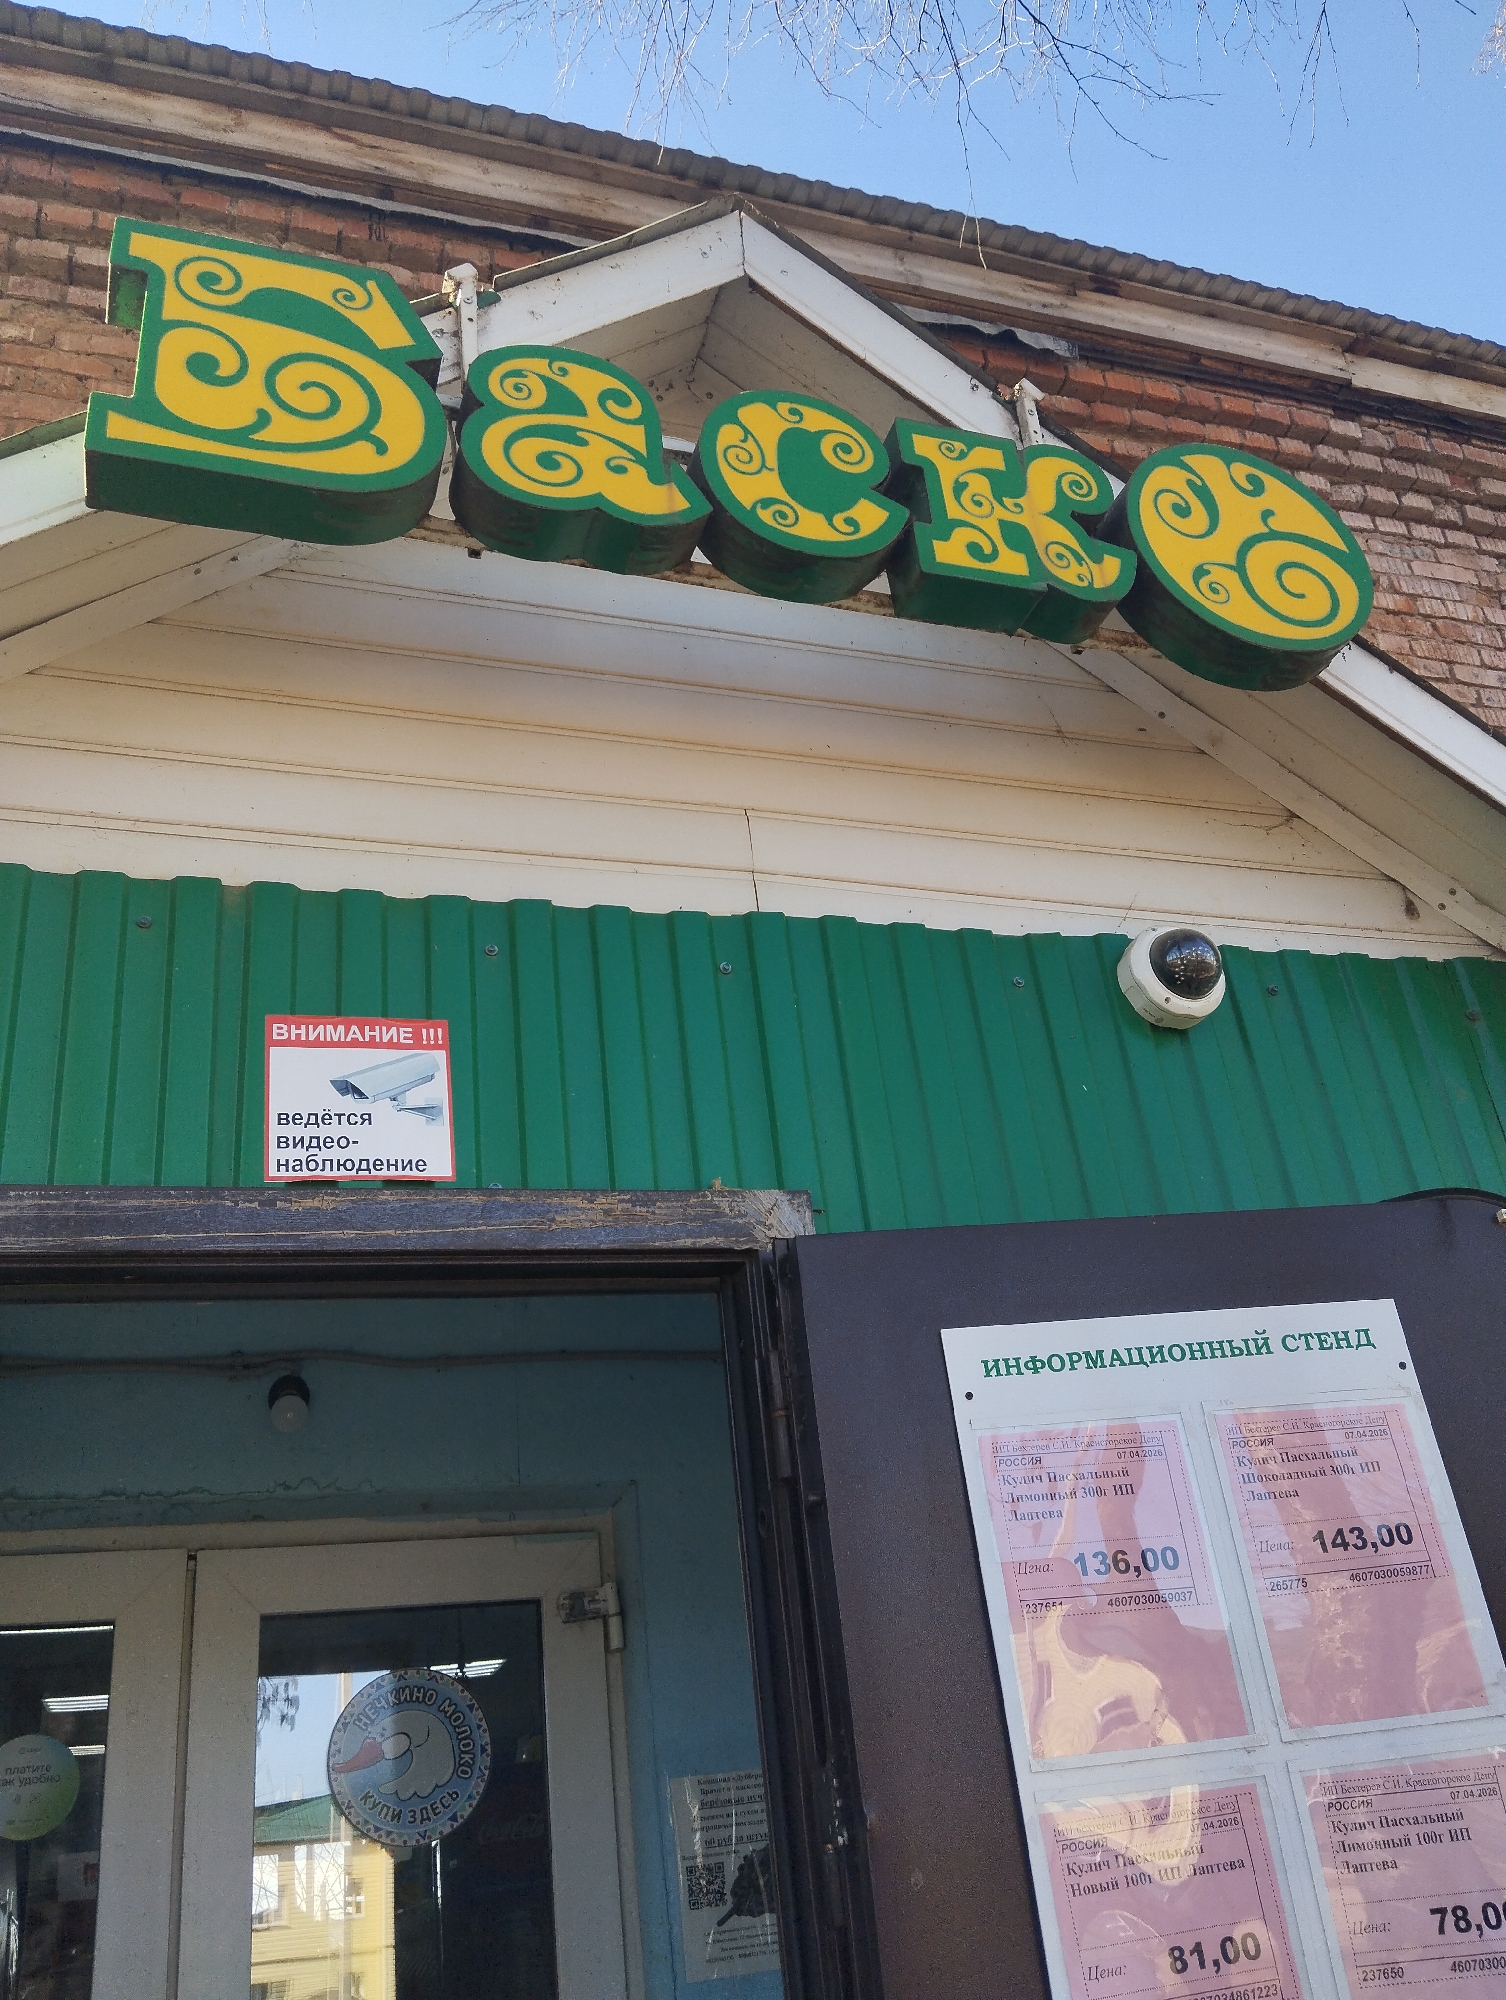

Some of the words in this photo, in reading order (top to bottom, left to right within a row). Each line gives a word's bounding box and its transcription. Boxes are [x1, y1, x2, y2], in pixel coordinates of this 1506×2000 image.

[271, 1023, 414, 1044] ВНИМАНИЕ
[421, 1027, 443, 1045] !!!
[276, 1108, 373, 1129] ведётся
[276, 1135, 360, 1152] видео-
[275, 1153, 428, 1175] наблюдение
[980, 1329, 1274, 1379] ИНФОРМАЦИОННЫЙ
[1281, 1327, 1378, 1353] СТЕНД
[1231, 1437, 1275, 1450] РОССИЯ
[1344, 1428, 1389, 1440] 07.04.2026
[998, 1456, 1043, 1468] РОССИЯ
[1116, 1449, 1163, 1460] 07.04.2026
[1236, 1454, 1278, 1469] Кулич
[1279, 1446, 1359, 1464] Пасхальный
[1001, 1472, 1044, 1488] Кулич
[1046, 1467, 1130, 1483] Пасхальный
[1240, 1466, 1327, 1485] Шоколадный
[1329, 1463, 1357, 1477] 300г
[1359, 1460, 1382, 1474] ИП
[1004, 1487, 1078, 1504] Лимонный
[1081, 1485, 1110, 1499] 300г
[1113, 1483, 1136, 1496] ИП
[1246, 1488, 1300, 1502] Лаптева
[1008, 1509, 1064, 1522] Лаптева
[1258, 1539, 1295, 1553] Цена:
[1311, 1521, 1414, 1554] 143,00
[1017, 1562, 1055, 1576] Цена:
[1073, 1545, 1180, 1578] 136,00
[1269, 1578, 1308, 1592] 265775
[1349, 1564, 1430, 1582] 4607030059877
[1025, 1600, 1064, 1615] 237651
[1107, 1590, 1194, 1607] 4607030059037
[353, 1685, 438, 1731] НЕЧКИНО
[438, 1697, 476, 1780] МОЛОКО
[1340, 1781, 1381, 1795] Бехтерев
[1405, 1773, 1472, 1789] Красногорское
[358, 1789, 403, 1824] КУПИ
[407, 1789, 460, 1826] ЗДЕСЬ
[1327, 1798, 1374, 1812] РОССИЯ
[1450, 1786, 1498, 1801] 07.04.2026
[1061, 1836, 1109, 1853] РОССИЯ
[1190, 1816, 1240, 1833] 07.04.2026
[1331, 1818, 1377, 1837] Кулич
[1378, 1808, 1465, 1829] Пасхальный
[1335, 1836, 1412, 1854] Лимонный
[1416, 1831, 1445, 1847] 100г
[1449, 1826, 1473, 1843] ИП
[1066, 1858, 1111, 1878] Кулич
[1115, 1843, 1205, 1868] Пасхальный
[1340, 1858, 1398, 1875] Лаптева
[1070, 1877, 1120, 1898] Новый
[1158, 1866, 1182, 1882] ИП
[1187, 1858, 1246, 1877] Лаптева
[1352, 1920, 1392, 1936] Цена:
[1429, 1901, 1506, 1939] 78,0
[1087, 1963, 1127, 1982] Цена:
[1167, 1931, 1262, 1975] 81,00
[1361, 1967, 1405, 1983] 237650
